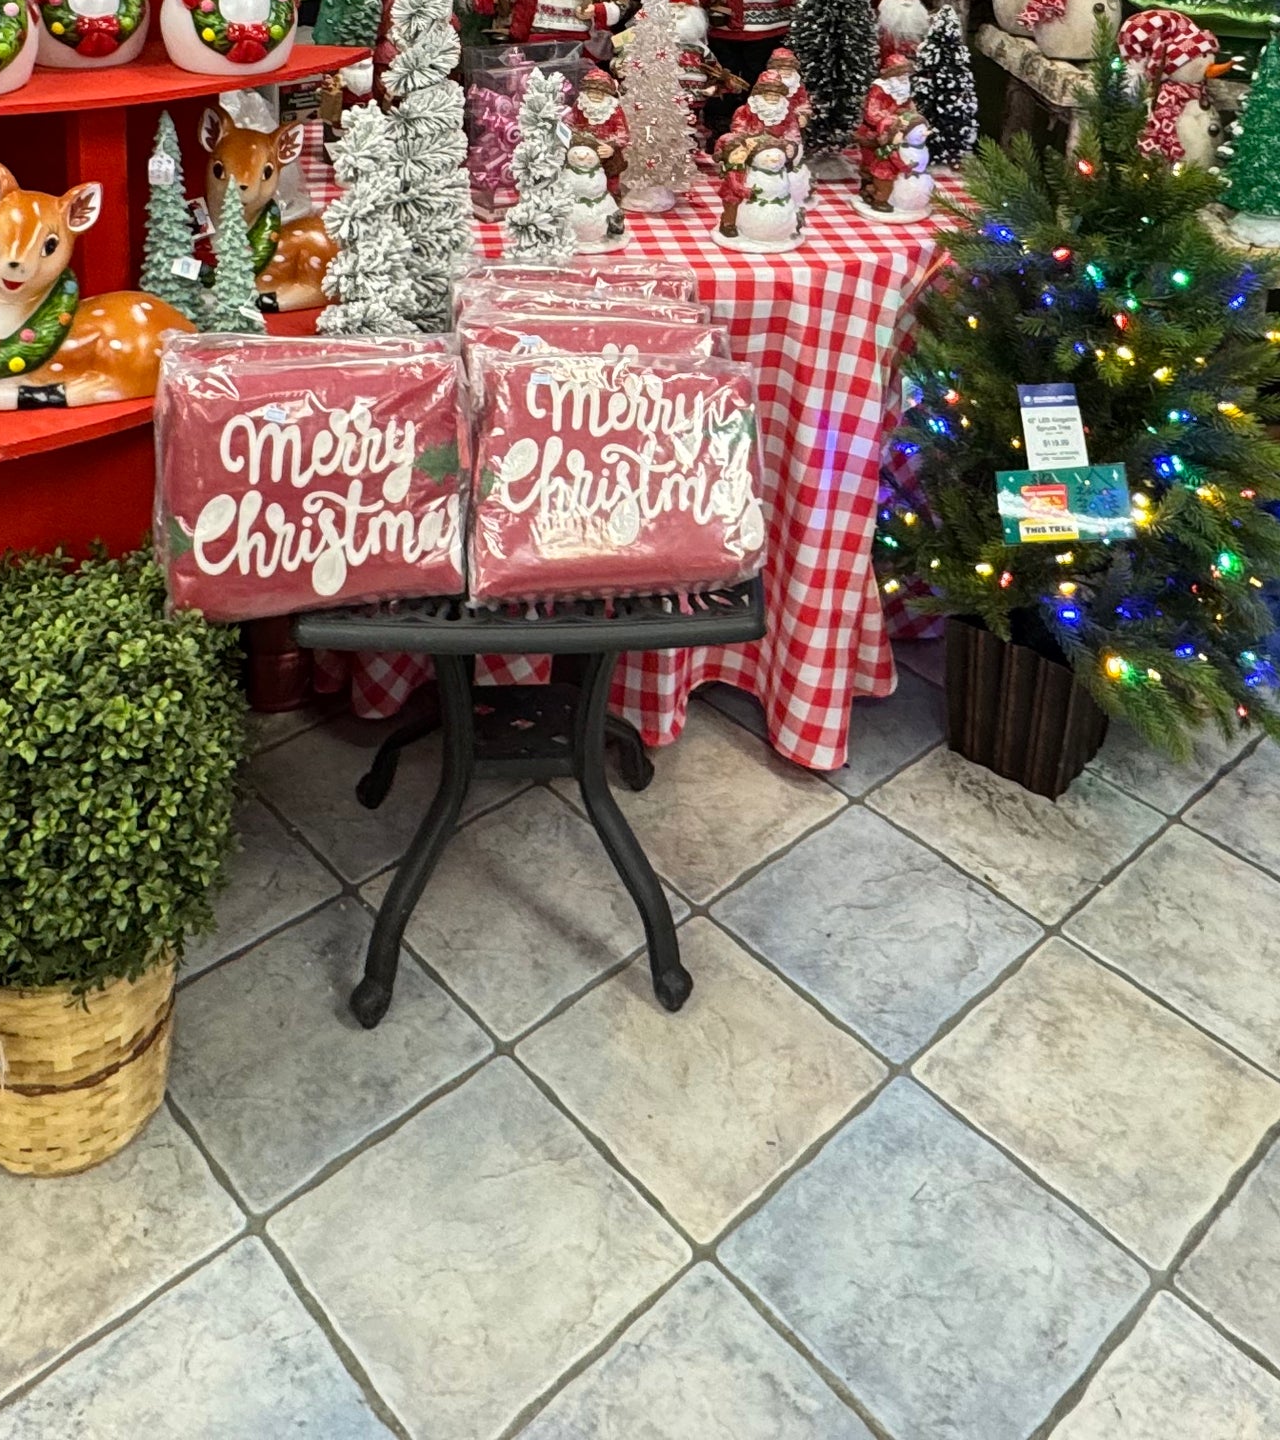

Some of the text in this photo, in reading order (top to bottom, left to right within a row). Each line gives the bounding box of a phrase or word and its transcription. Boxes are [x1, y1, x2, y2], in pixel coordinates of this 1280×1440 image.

[220, 410, 416, 503] Merry
[526, 371, 704, 470] Merry
[194, 479, 463, 597] Christmas
[501, 430, 765, 552] Christmas
[1024, 525, 1073, 534] THIS TREE
